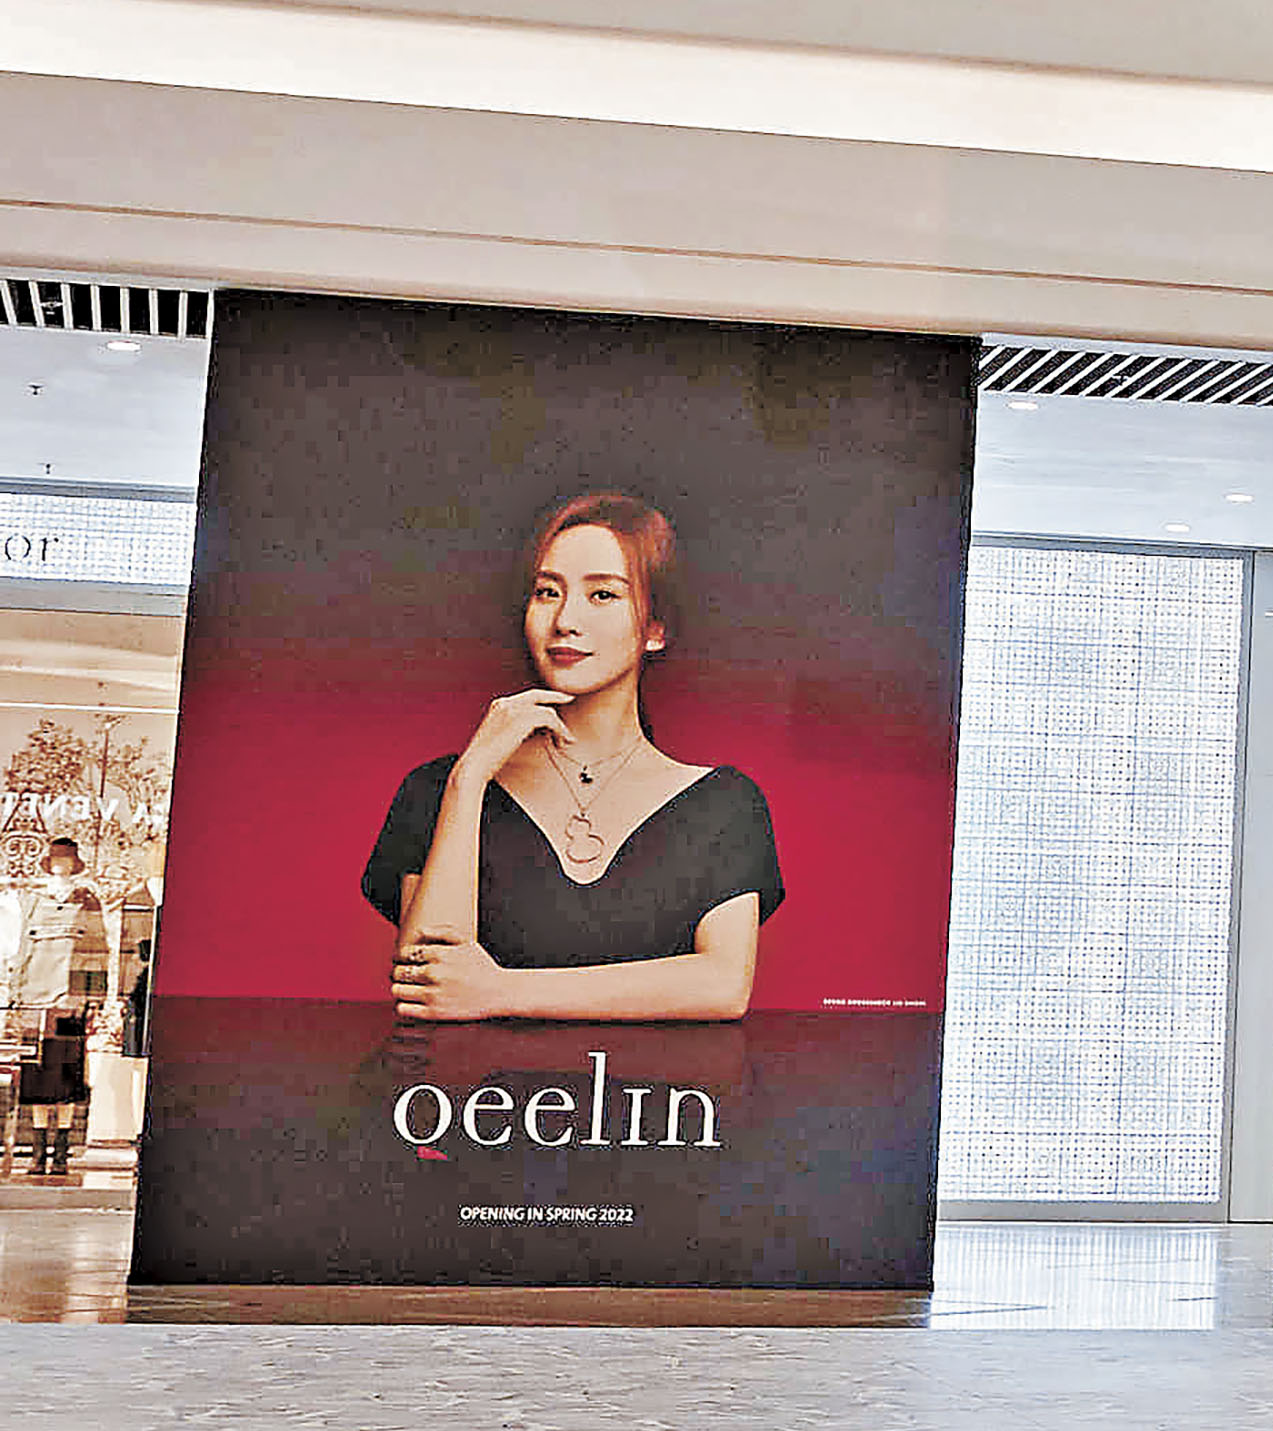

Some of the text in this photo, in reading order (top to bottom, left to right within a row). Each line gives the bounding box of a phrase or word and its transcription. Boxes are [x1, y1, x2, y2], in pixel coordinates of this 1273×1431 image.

[460, 1206, 634, 1222] OPENING IN SPRING 2022
